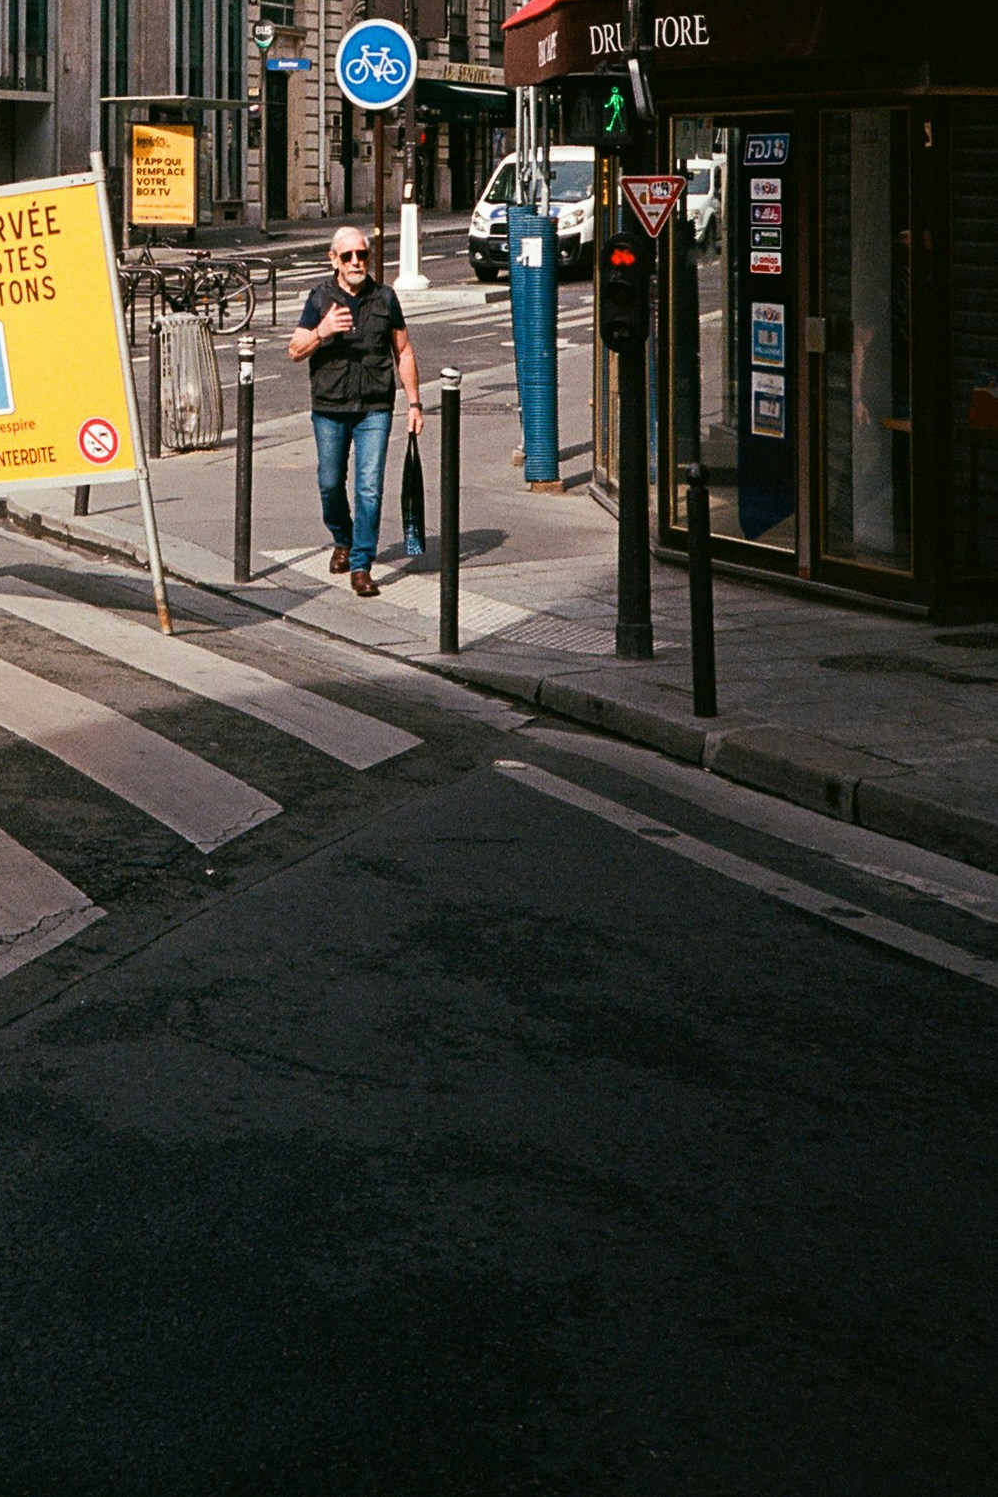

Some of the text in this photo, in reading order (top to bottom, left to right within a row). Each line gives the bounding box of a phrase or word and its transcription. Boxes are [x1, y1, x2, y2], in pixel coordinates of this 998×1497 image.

[255, 25, 272, 36] BUS
[747, 139, 772, 159] FDJ
[136, 157, 182, 166] L'APP QUI
[136, 167, 186, 176] REMPLACE
[136, 177, 167, 186] VOTRE
[136, 187, 171, 196] BOX TV
